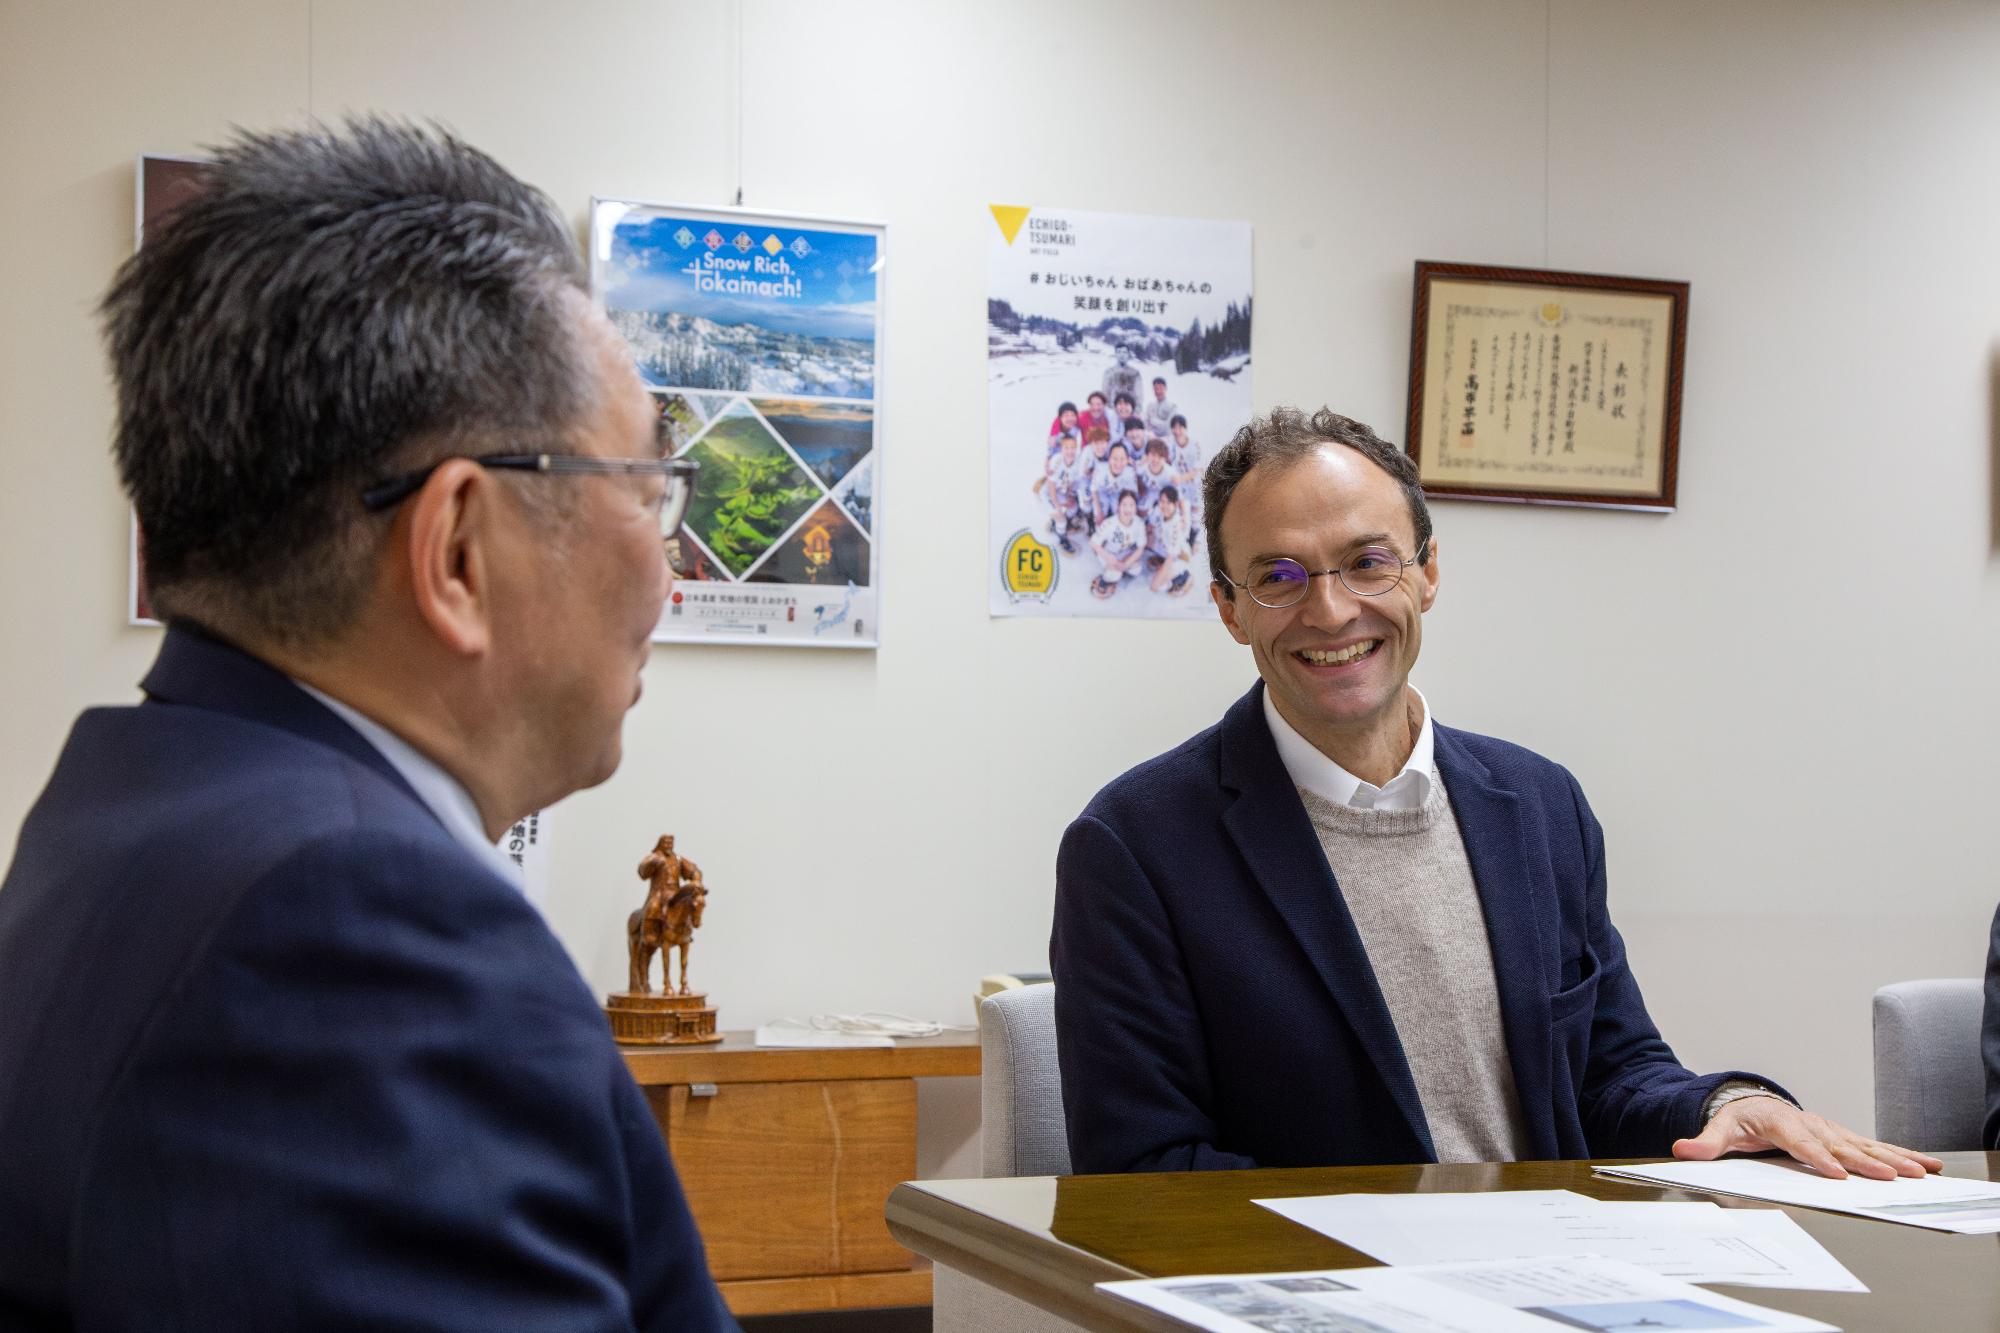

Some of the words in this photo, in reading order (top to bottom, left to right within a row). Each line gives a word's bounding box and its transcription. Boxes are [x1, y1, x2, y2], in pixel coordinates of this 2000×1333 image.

[1029, 231, 1076, 246] TSUMARI
[703, 251, 751, 272] Snow
[754, 255, 796, 276] Rich.
[1045, 271, 1118, 290] おじいちゃん
[1124, 276, 1212, 294] おばあちゃんの
[1073, 295, 1169, 315] 笑顔を創り出す
[1018, 549, 1043, 572] FC
